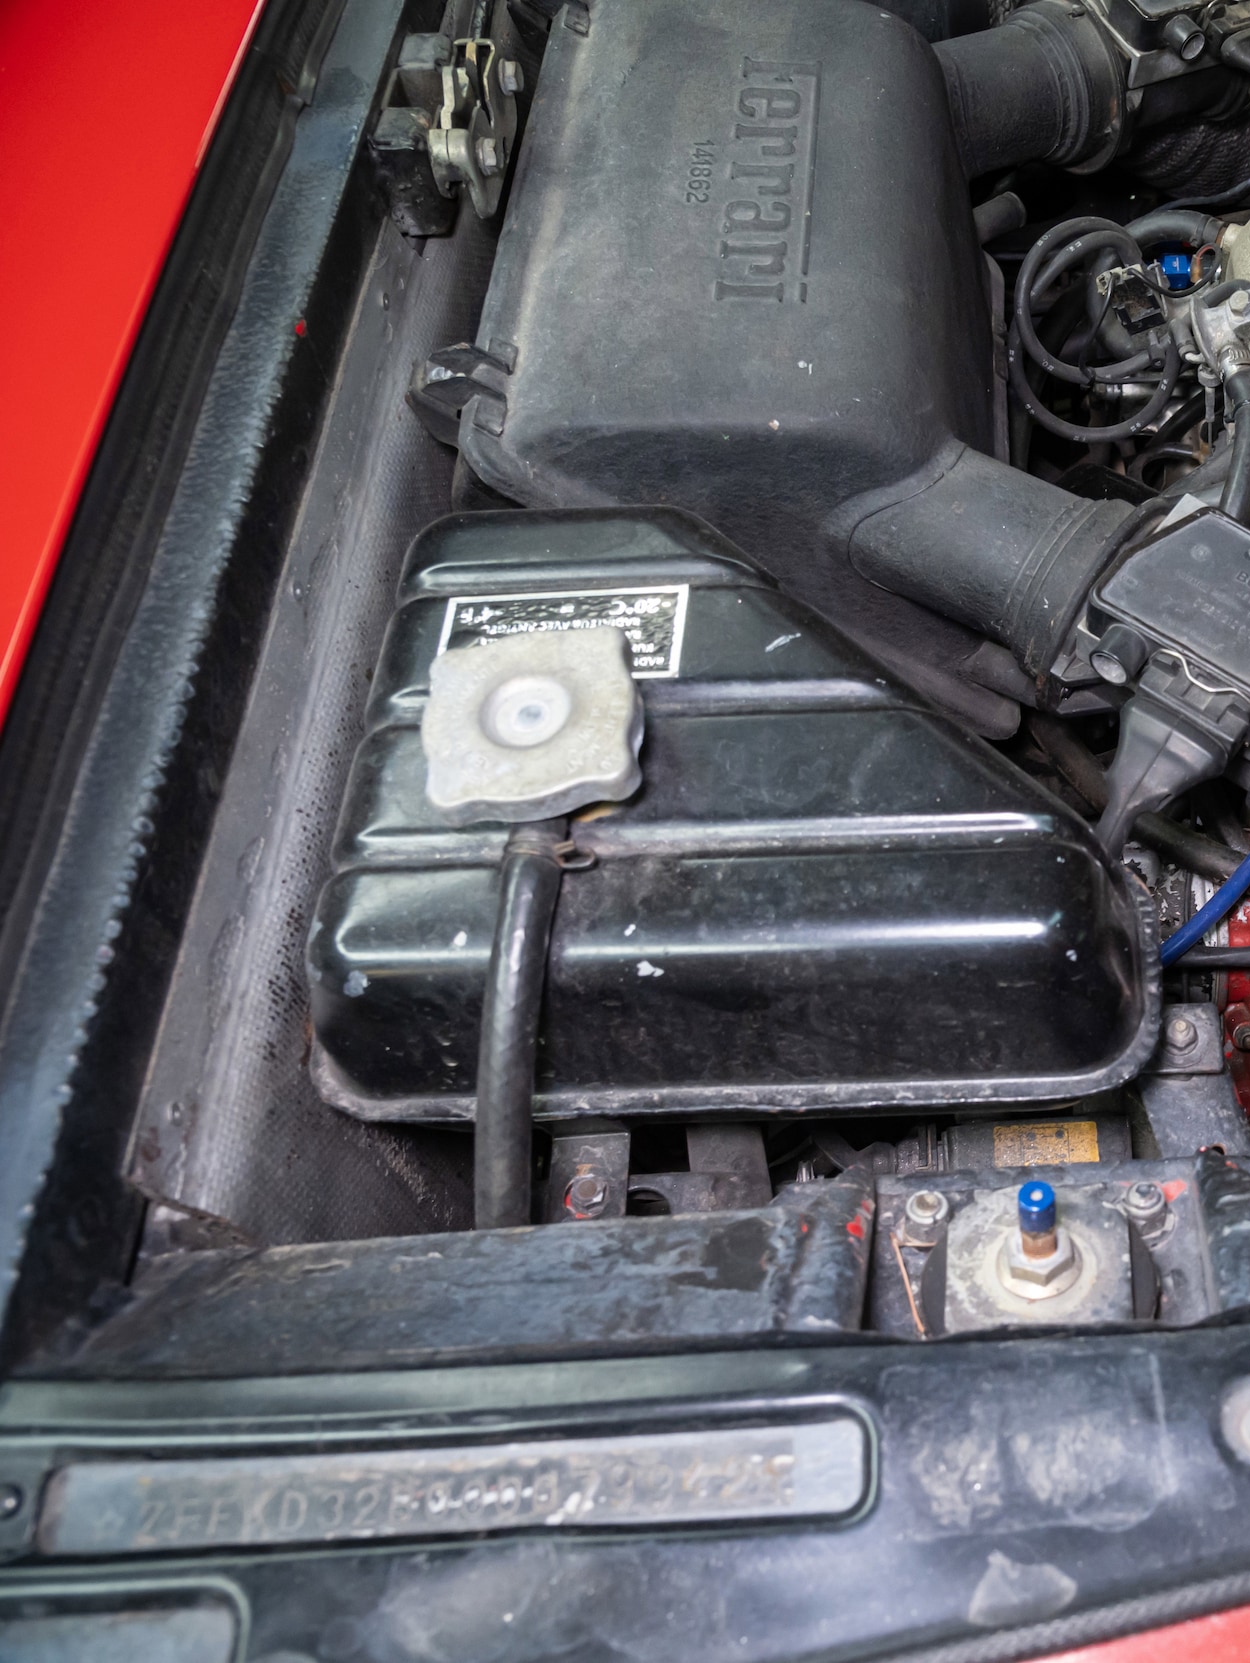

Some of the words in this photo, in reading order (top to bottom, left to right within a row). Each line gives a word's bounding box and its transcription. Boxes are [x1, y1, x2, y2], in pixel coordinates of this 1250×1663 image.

[685, 138, 716, 204] 141862
[714, 56, 822, 303] Ferrari
[537, 620, 571, 632] AVEC
[608, 597, 672, 615] -20°C
